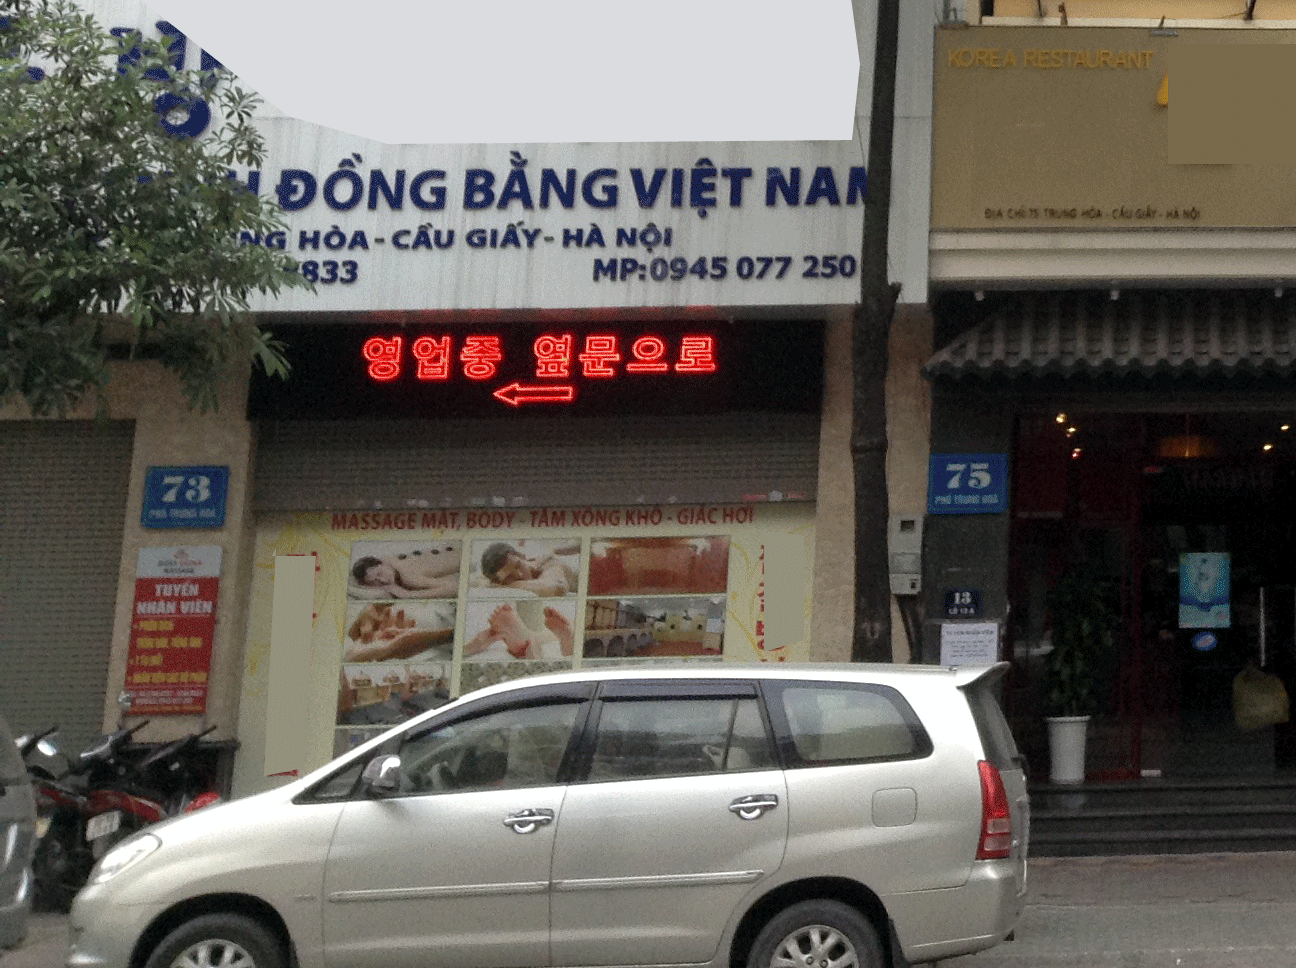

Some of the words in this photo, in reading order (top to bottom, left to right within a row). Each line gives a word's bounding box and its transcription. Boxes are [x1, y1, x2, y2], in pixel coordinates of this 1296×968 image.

[949, 48, 1018, 69] KOREA
[1024, 48, 1155, 69] RESTAURANT
[275, 152, 448, 212] ĐỒNG
[463, 150, 620, 211] BẰNG
[630, 157, 753, 219] VIỆT
[1044, 208, 1078, 220] TRUNG
[298, 224, 369, 251] HÒA
[392, 222, 455, 251] CẦU
[562, 223, 605, 249] HÀ
[615, 222, 673, 254] NỘI
[593, 255, 728, 282] MP:0945
[736, 255, 793, 281] 077
[802, 254, 857, 280] 250
[363, 335, 502, 380] 영업중
[533, 334, 717, 377] 옆문으로
[162, 475, 211, 503] 73
[946, 463, 992, 489] 75
[331, 510, 417, 530] MASSAGE
[466, 510, 516, 529] BODY
[954, 591, 972, 605] 13
